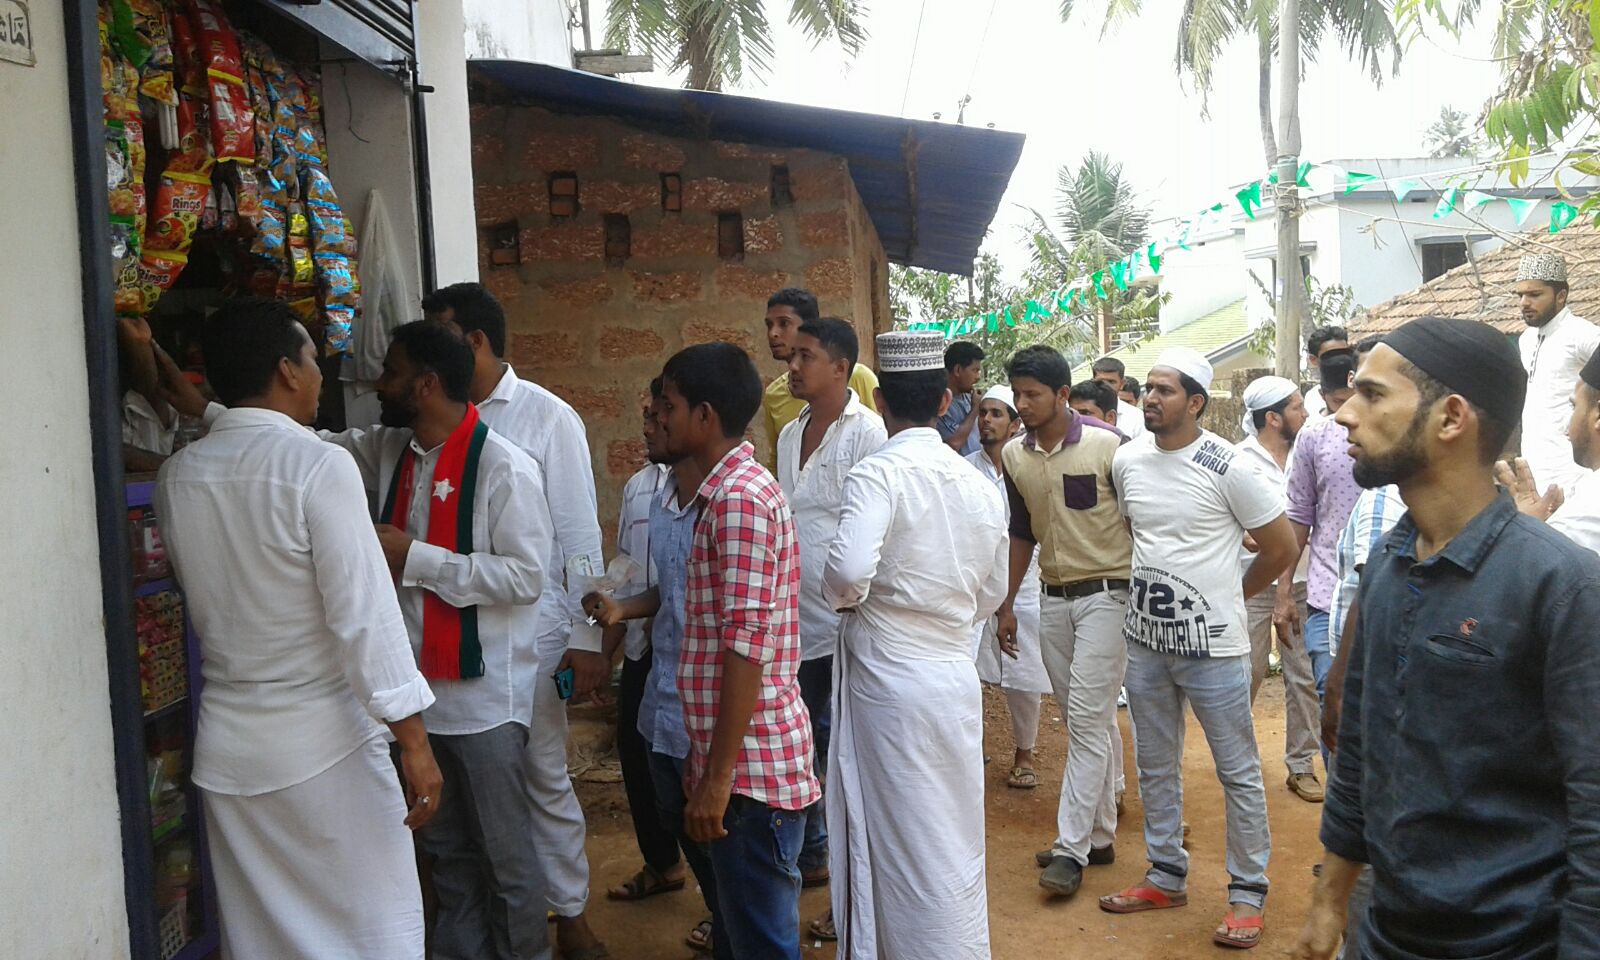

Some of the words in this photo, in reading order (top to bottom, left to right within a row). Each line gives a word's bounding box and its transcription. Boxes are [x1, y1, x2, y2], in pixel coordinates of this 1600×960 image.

[172, 197, 200, 211] Rings
[138, 266, 168, 284] Rings
[1192, 450, 1229, 476] WORLD
[1200, 440, 1236, 462] SMILEY
[1133, 576, 1176, 619] 72
[1171, 574, 1199, 595] SEVENTY
[1198, 594, 1211, 611] TWO
